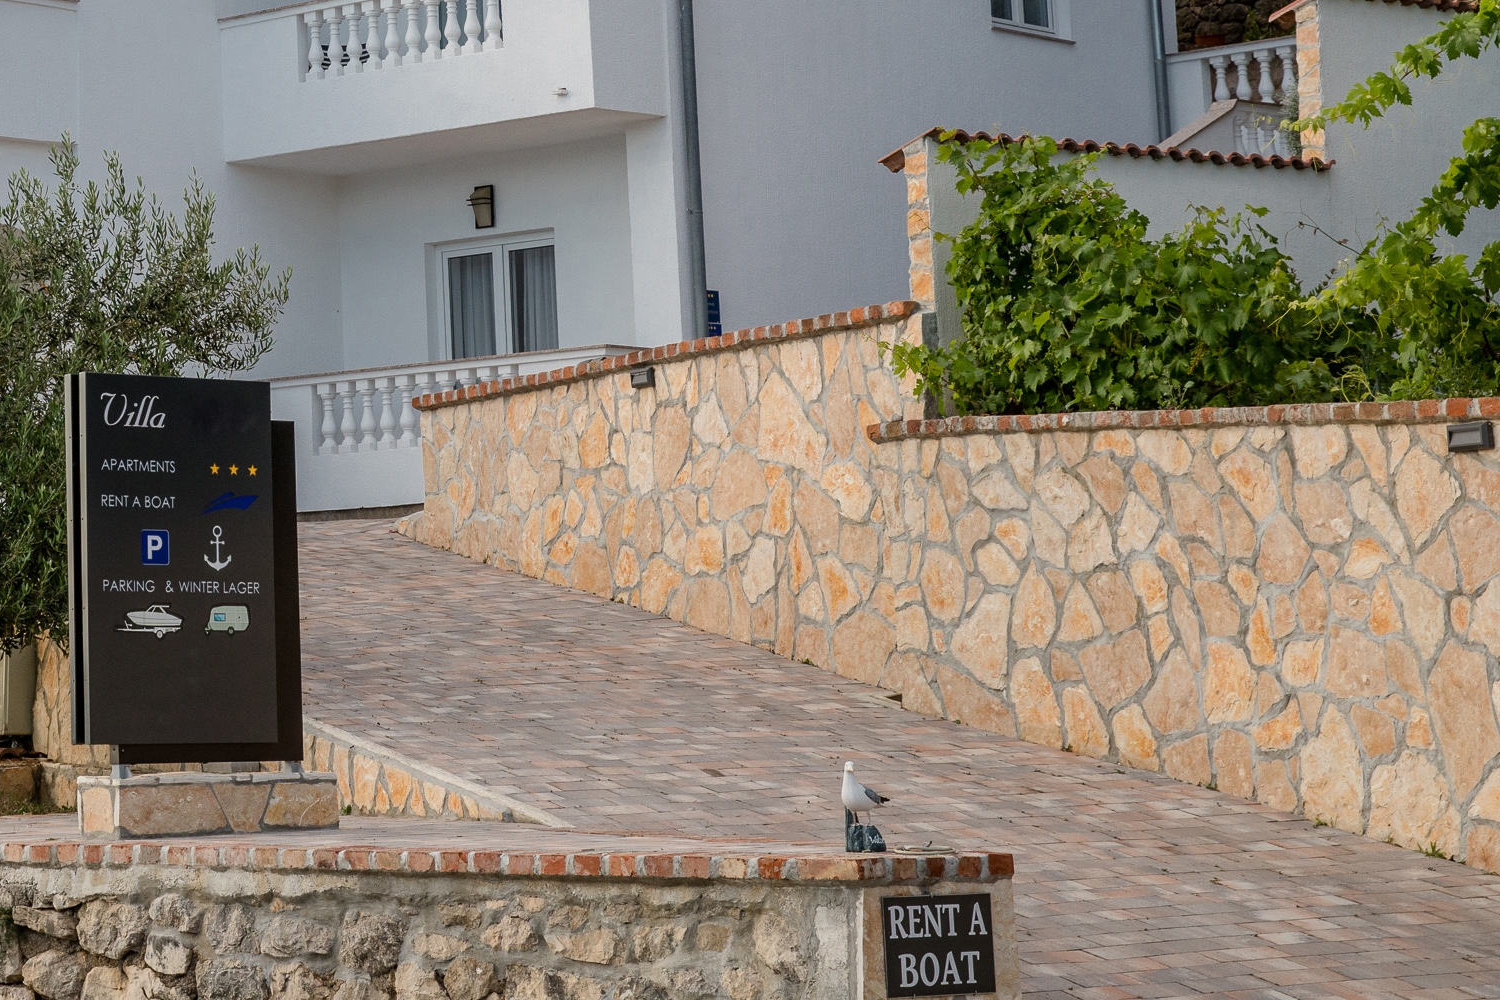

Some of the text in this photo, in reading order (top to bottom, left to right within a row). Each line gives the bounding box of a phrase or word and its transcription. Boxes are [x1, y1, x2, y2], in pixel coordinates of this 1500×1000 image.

[100, 391, 166, 429] Villa
[101, 458, 176, 474] APARTMENTS
[101, 494, 176, 509] RENT A BOAT
[146, 534, 163, 560] P
[102, 579, 260, 594] PARKING & WINTER LAGER
[887, 901, 988, 940] RENT A
[898, 950, 981, 989] BOAT
